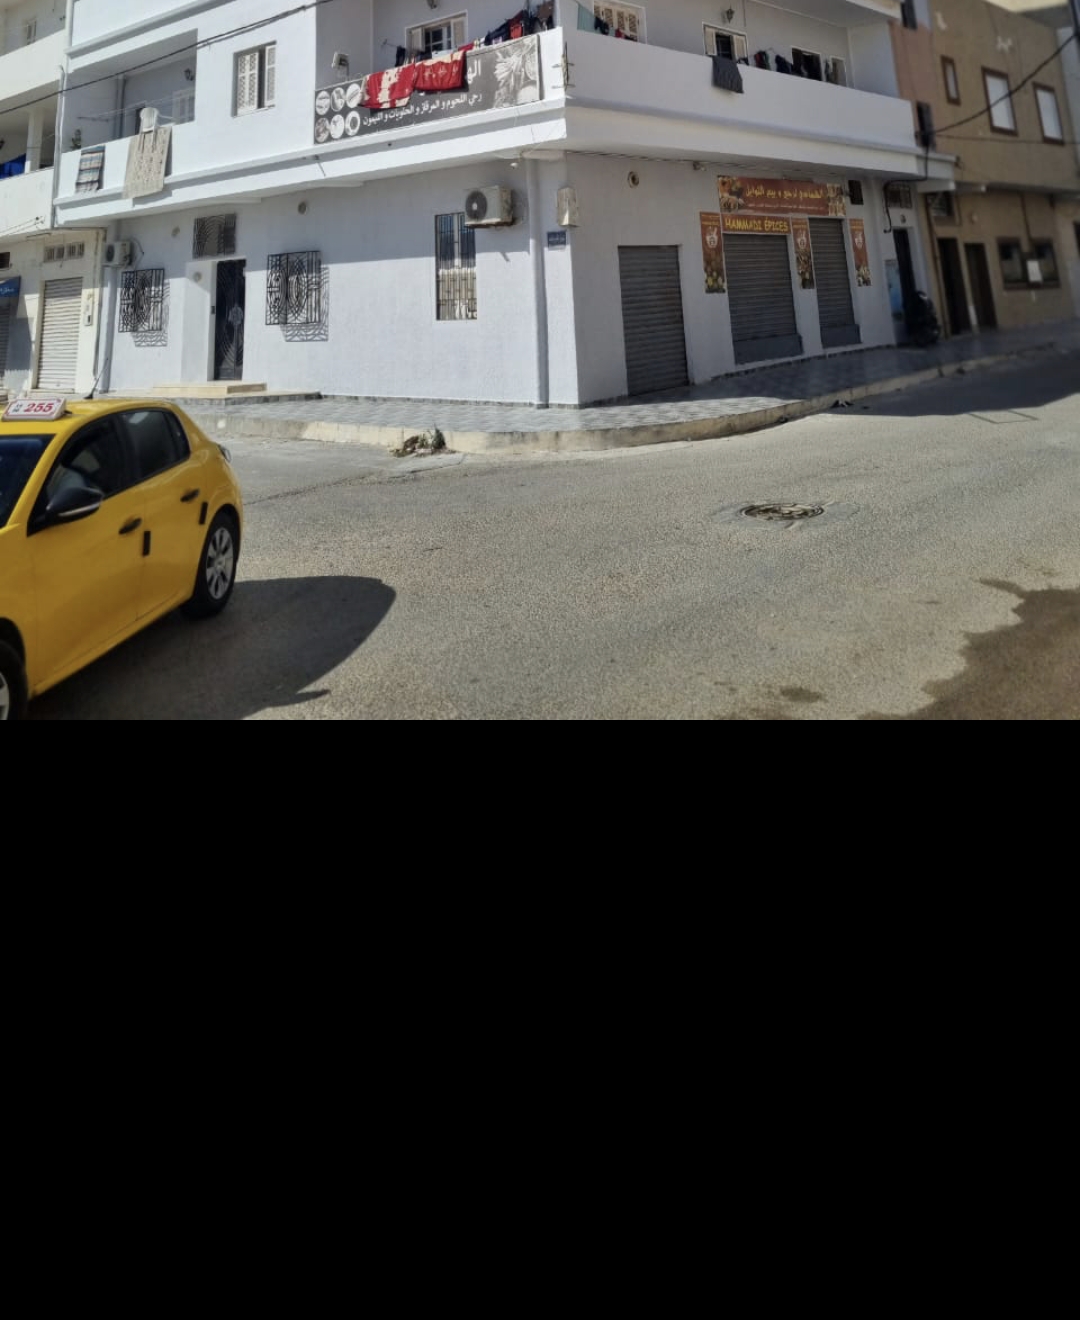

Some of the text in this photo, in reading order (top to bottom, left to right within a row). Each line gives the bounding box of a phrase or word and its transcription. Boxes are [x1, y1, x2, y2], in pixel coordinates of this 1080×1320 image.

[446, 93, 467, 110] اللحوم
[388, 104, 415, 122] الحلويات
[725, 218, 762, 231] HAMMADI
[23, 402, 55, 413] 255
